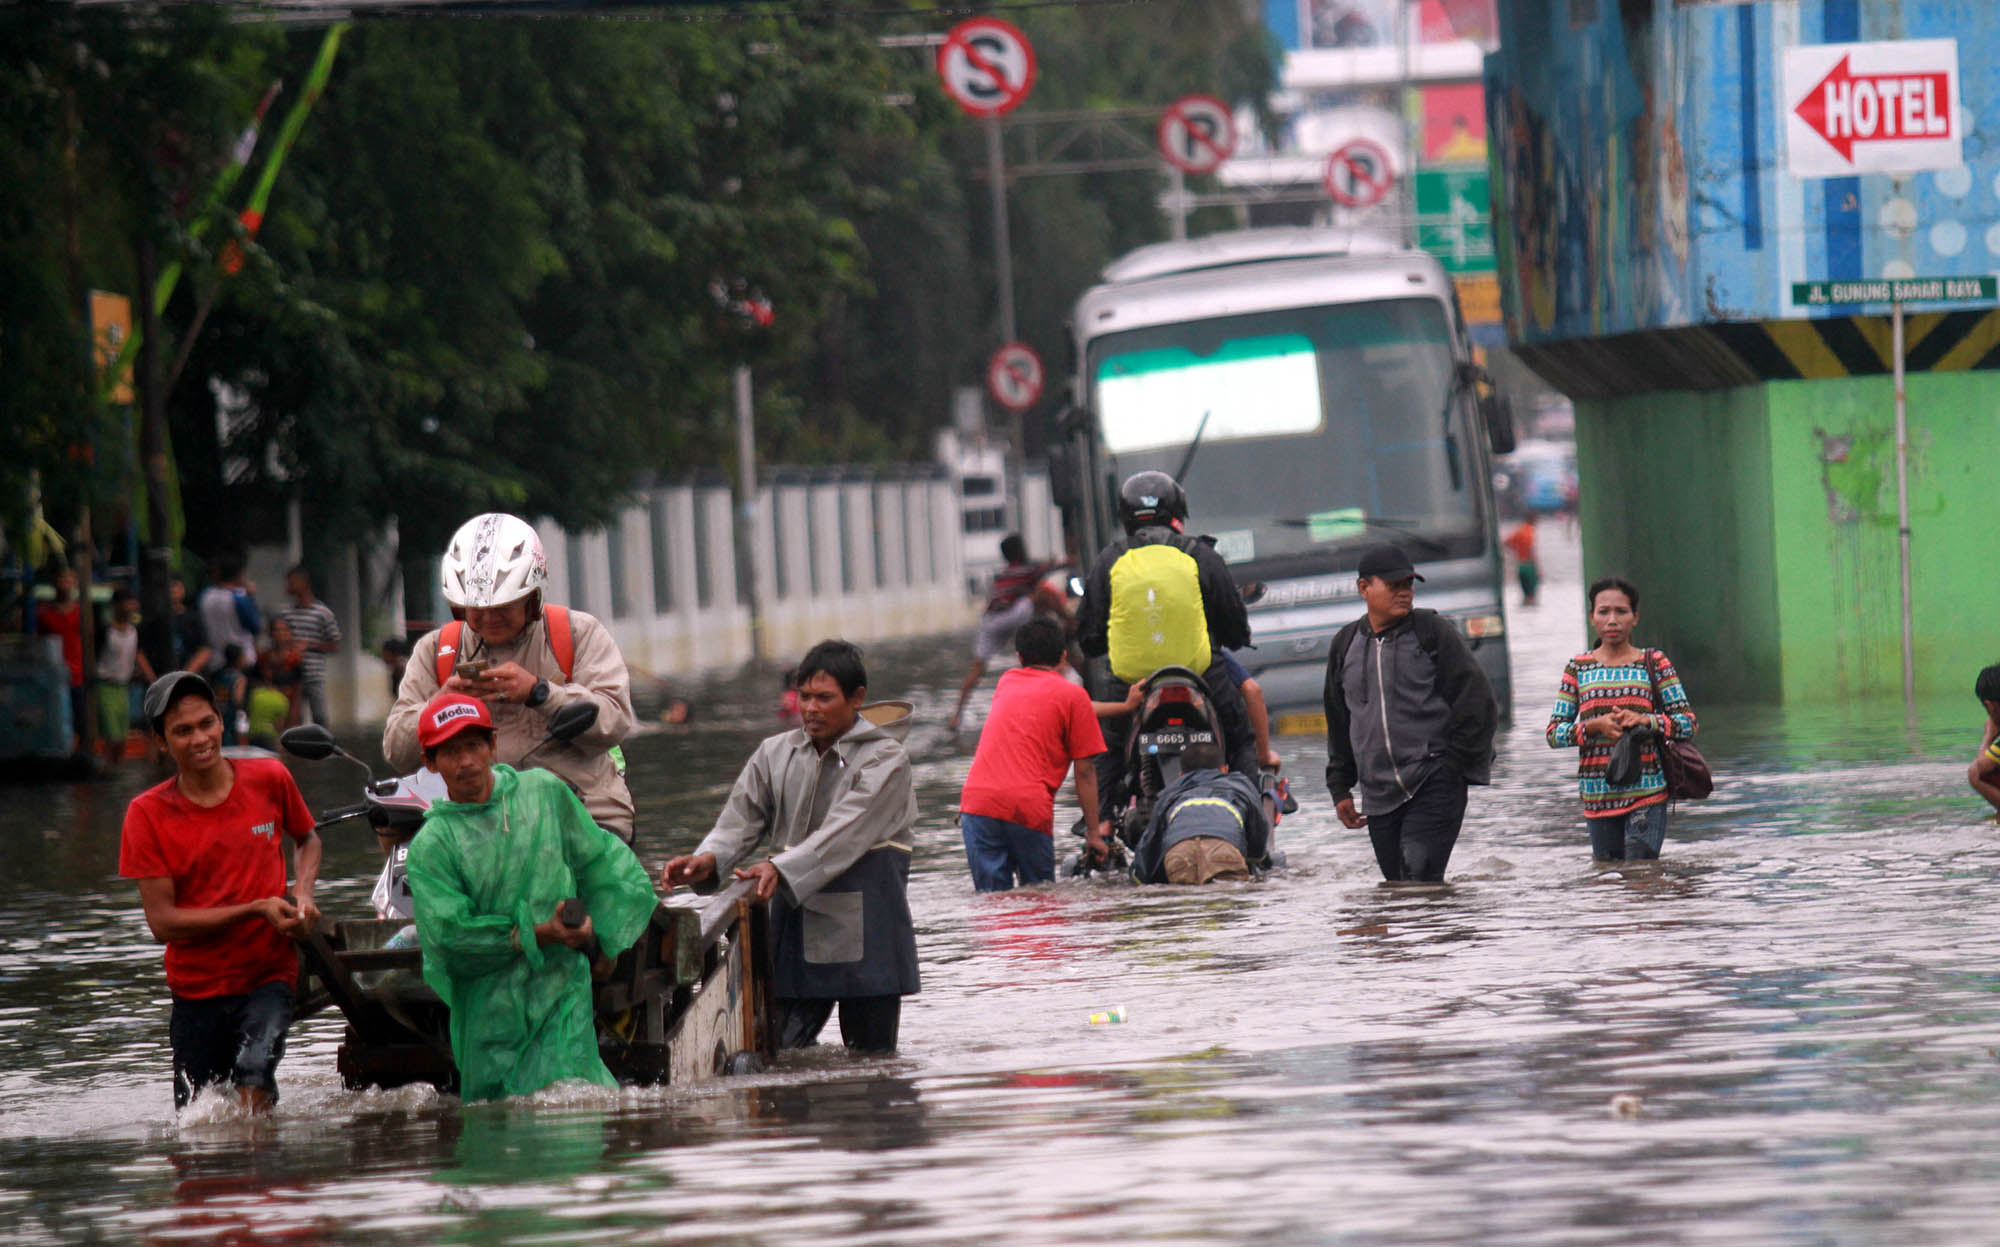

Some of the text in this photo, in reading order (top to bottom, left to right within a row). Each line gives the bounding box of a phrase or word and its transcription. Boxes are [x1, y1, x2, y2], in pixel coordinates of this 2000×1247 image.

[967, 36, 1010, 98] S
[1824, 77, 1947, 138] HOTEL
[1186, 112, 1217, 158] P
[1809, 280, 1982, 302] JL. GUNUNG SAHARI RAYA
[437, 706, 477, 724] Modus
